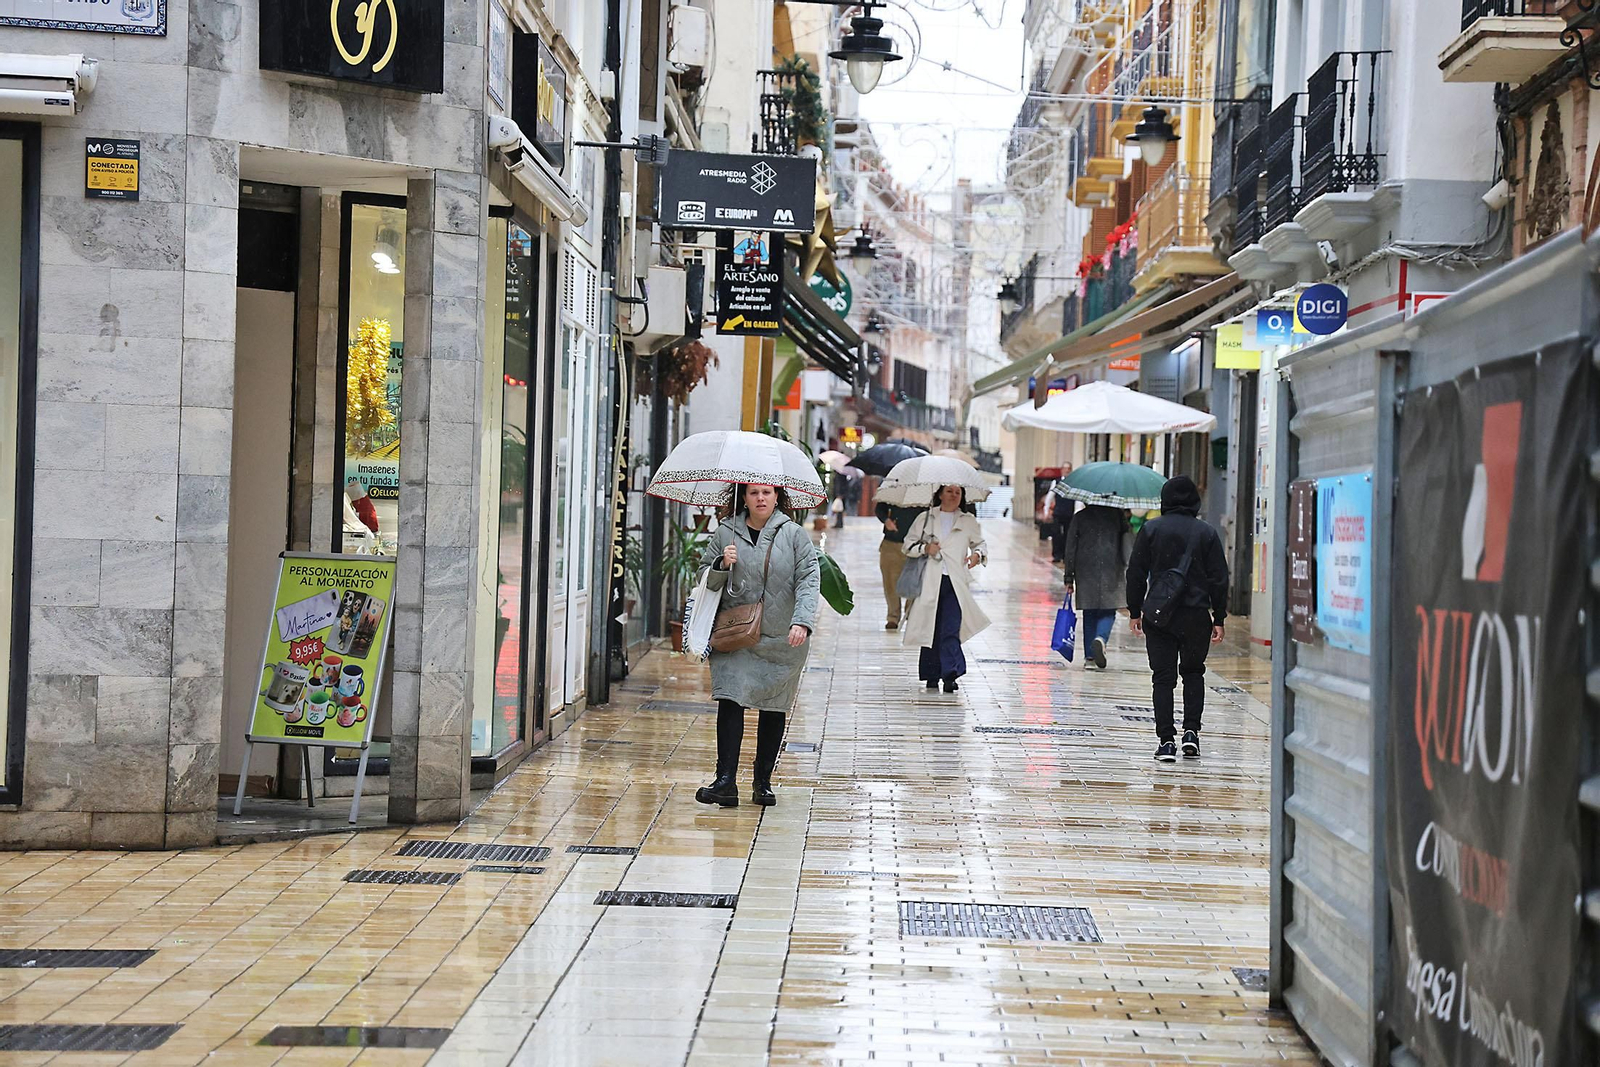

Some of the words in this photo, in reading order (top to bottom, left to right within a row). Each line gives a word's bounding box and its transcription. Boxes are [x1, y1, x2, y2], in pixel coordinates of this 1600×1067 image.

[699, 169, 747, 178] ATRESMEDIA
[725, 208, 751, 220] EUROPA
[724, 264, 736, 272] EL
[730, 286, 751, 294] Arreglo
[745, 294, 766, 302] calzado
[761, 303, 772, 311] piel
[1302, 300, 1340, 314] DIGI
[753, 321, 779, 329] GALERIA
[357, 464, 396, 475] Imagenes
[360, 475, 368, 485] tu
[370, 475, 392, 486] funda
[289, 566, 388, 579] PERSONALIZACIÓN
[300, 577, 313, 586] AL
[316, 578, 374, 589] MOMENTO
[283, 612, 326, 639] Martina
[295, 642, 319, 659] 9,95€
